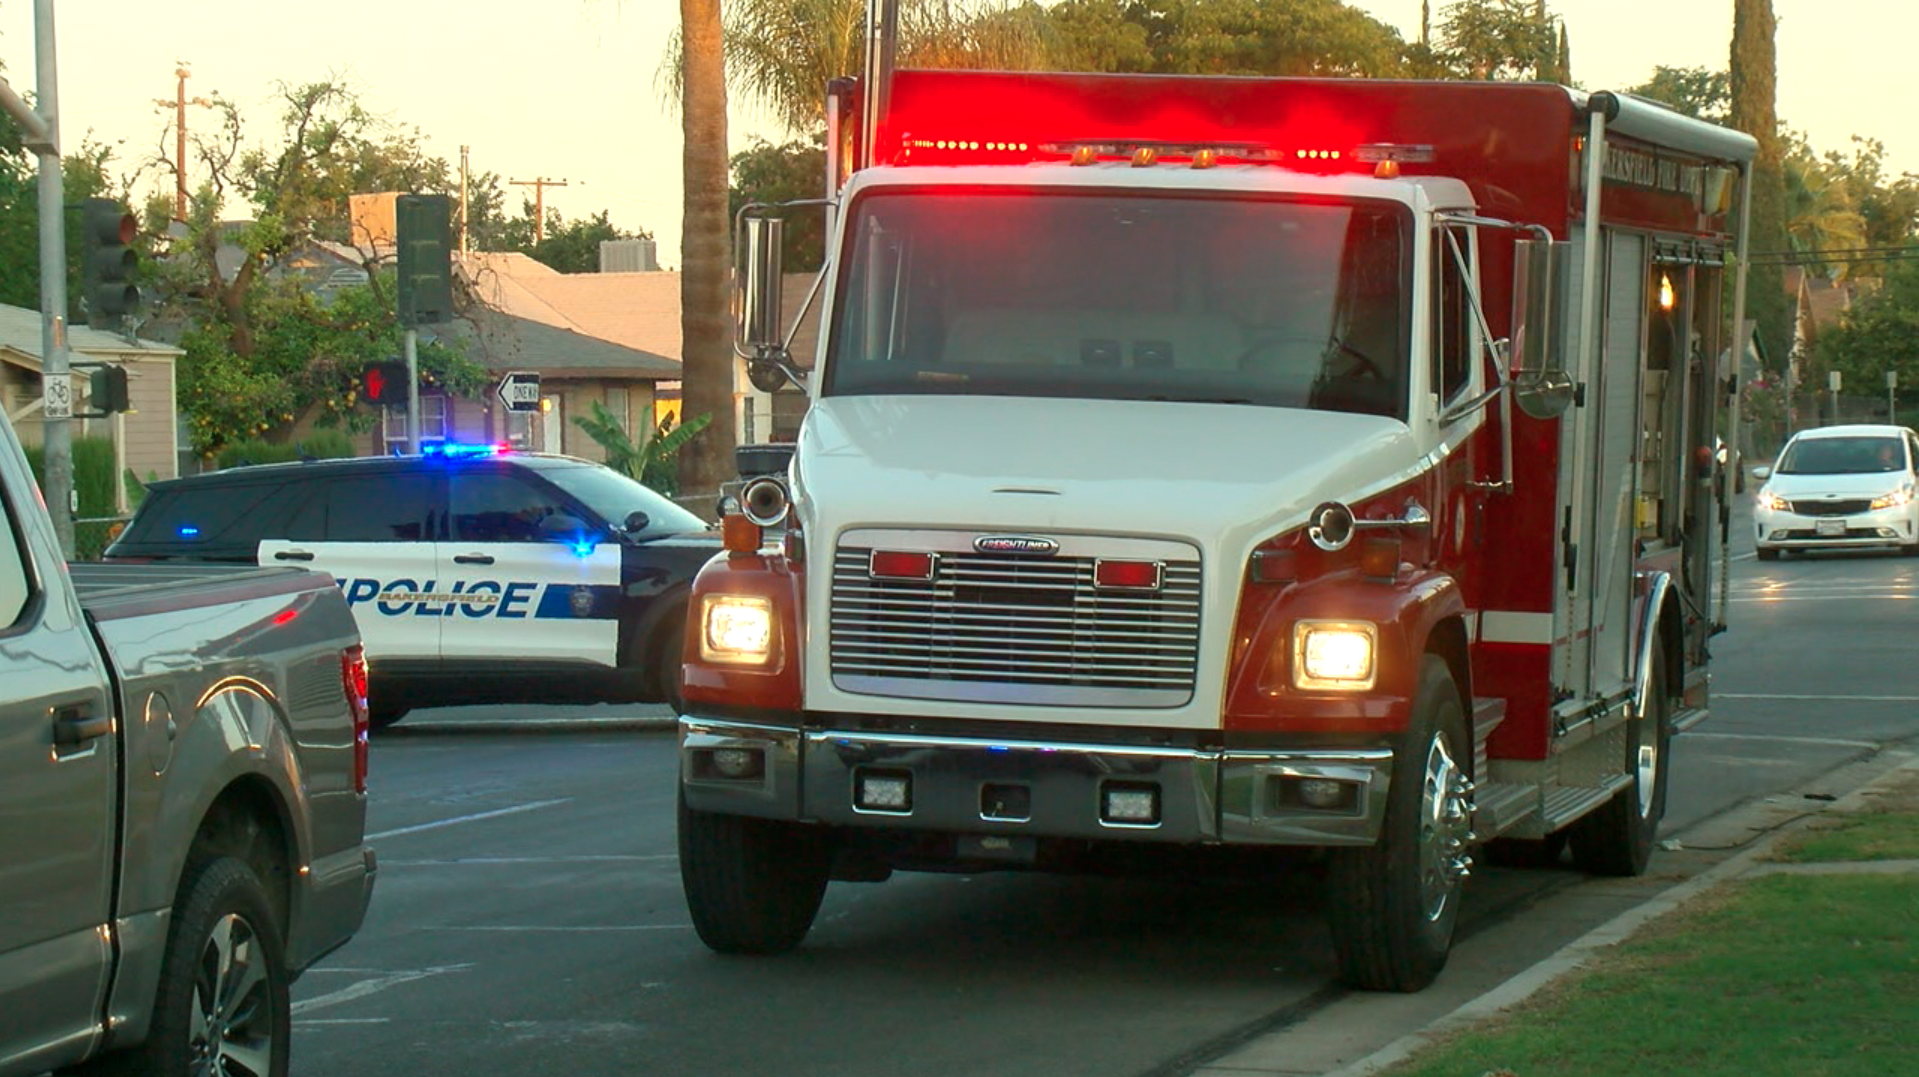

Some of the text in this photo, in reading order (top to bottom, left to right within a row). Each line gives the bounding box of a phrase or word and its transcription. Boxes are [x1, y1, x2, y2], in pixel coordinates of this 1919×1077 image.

[1604, 149, 1655, 186] KERSFIELD
[1657, 159, 1678, 191] FIRE
[514, 385, 527, 399] ONE
[981, 539, 1050, 551] FREIGHTLINER
[347, 578, 538, 618] POLICE
[378, 592, 500, 603] BAKERSFIELD
